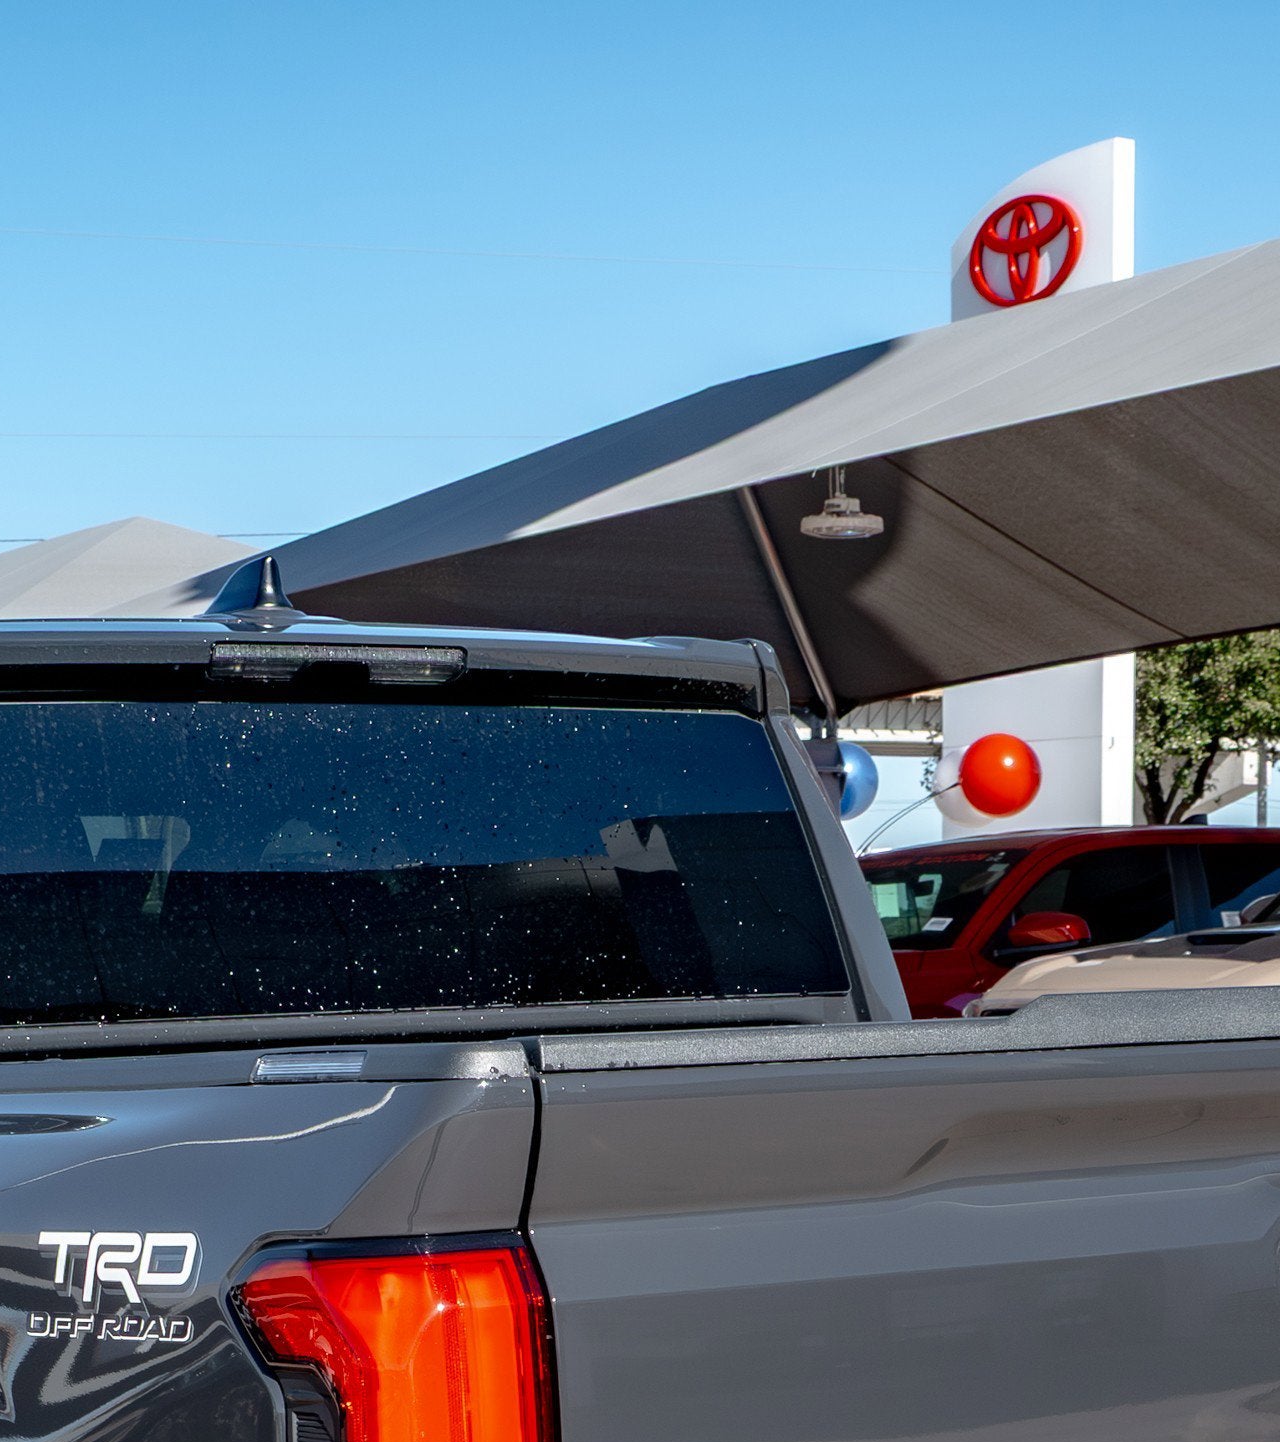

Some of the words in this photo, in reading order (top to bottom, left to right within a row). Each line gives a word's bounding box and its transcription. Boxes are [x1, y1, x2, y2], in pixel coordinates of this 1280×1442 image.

[37, 1231, 198, 1304] TRD
[26, 1311, 95, 1339] OFF
[96, 1314, 195, 1343] ROAD
